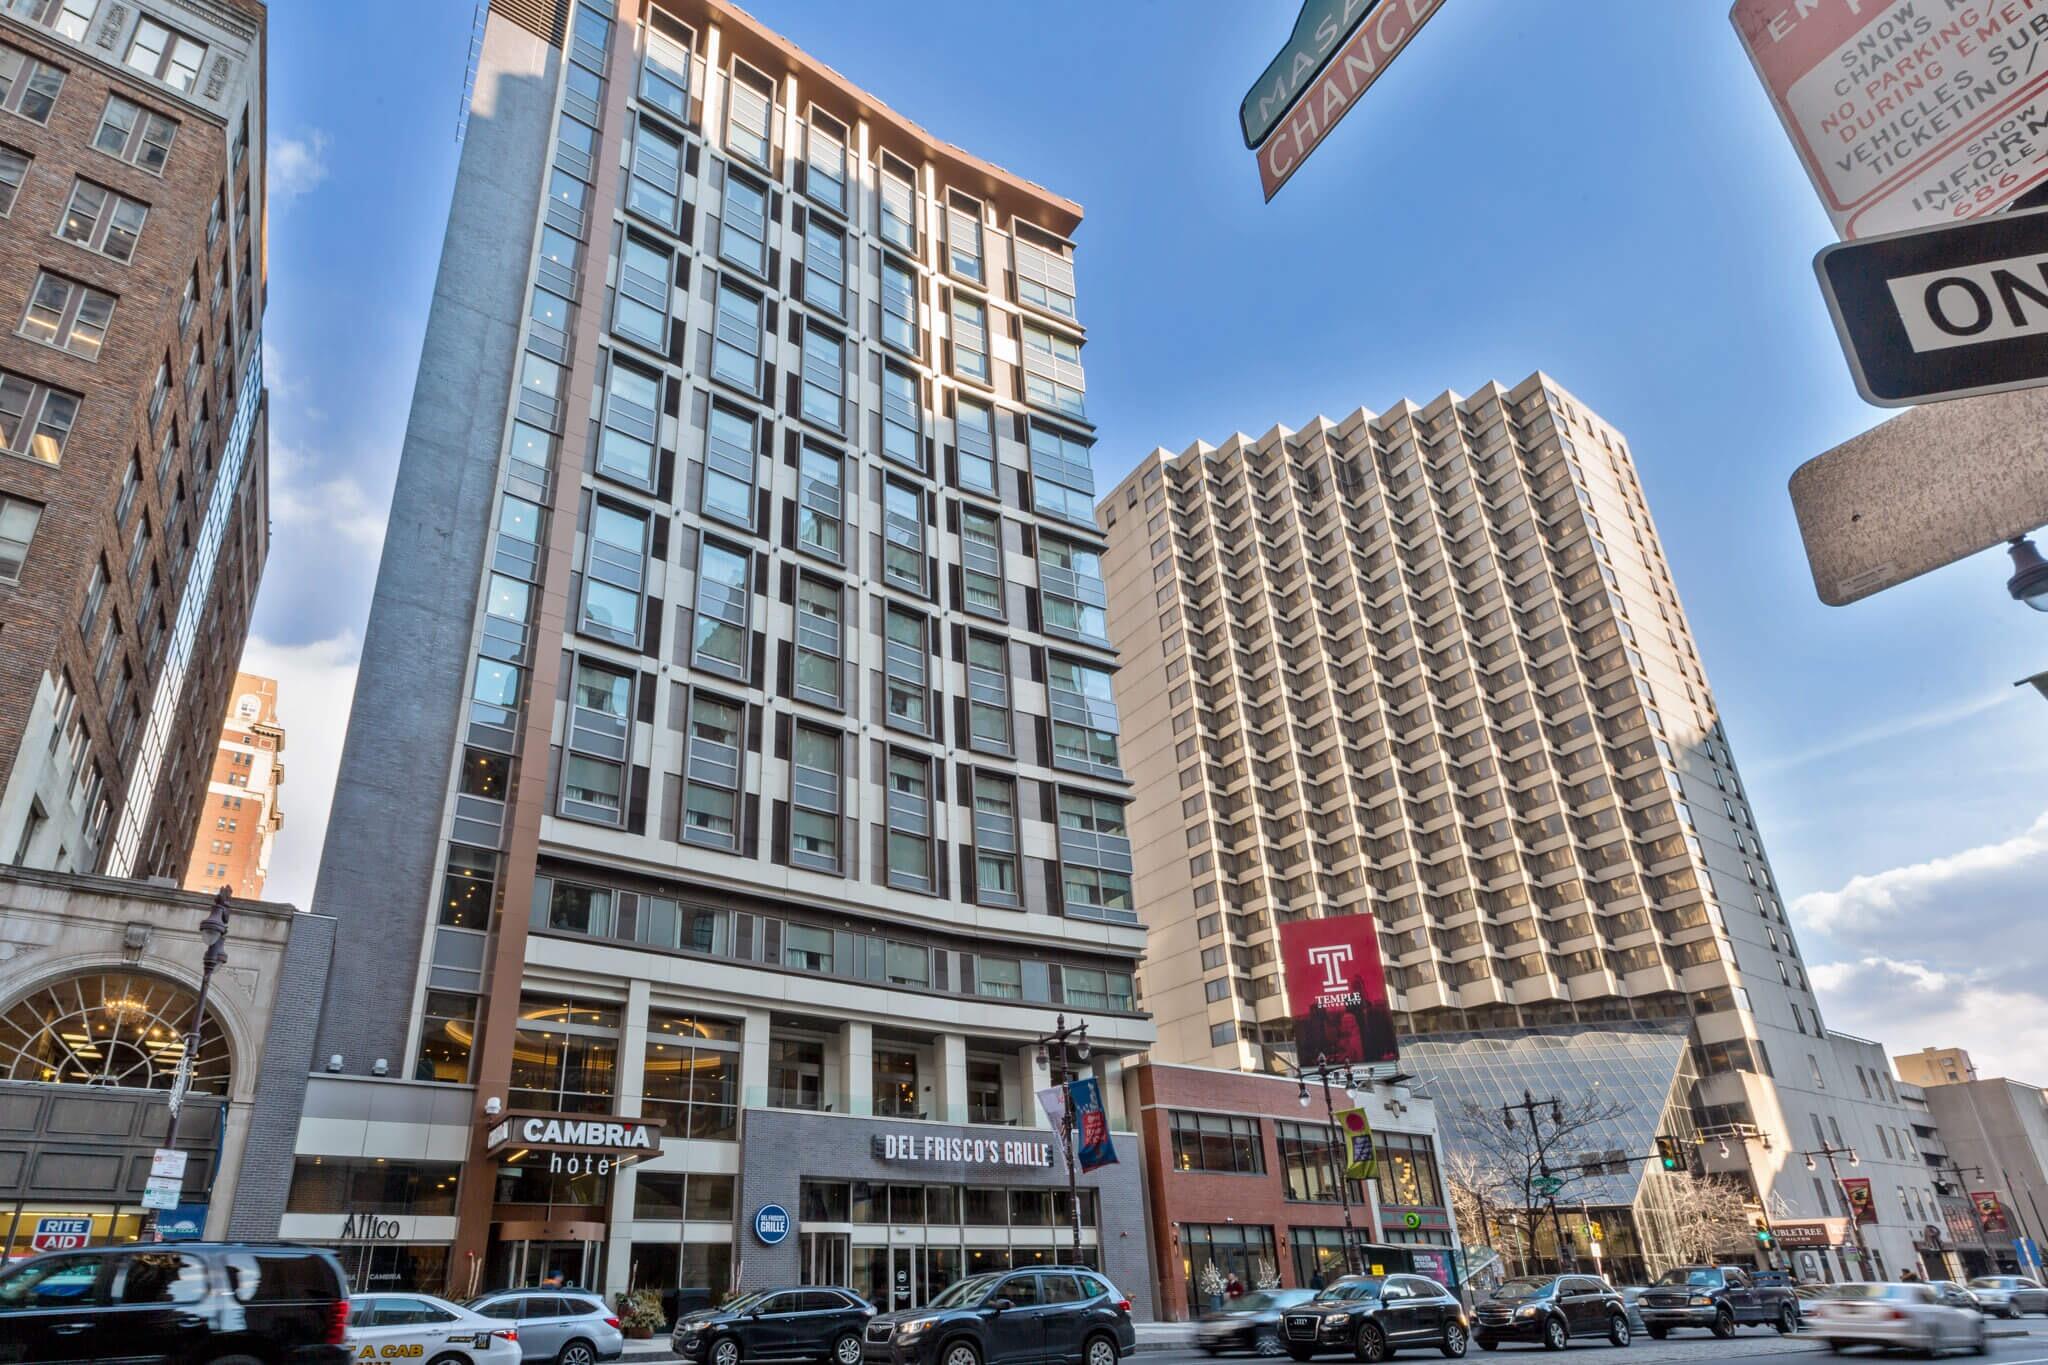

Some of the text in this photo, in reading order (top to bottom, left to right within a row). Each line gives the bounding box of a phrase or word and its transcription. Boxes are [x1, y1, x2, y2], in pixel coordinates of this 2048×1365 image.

[1840, 2, 1915, 69] SNOW
[1834, 16, 1932, 97] CHAINS
[1839, 0, 2033, 144] DURING EME
[1820, 102, 1856, 135] NO
[1836, 69, 1974, 173] VEHICLES
[1966, 105, 2036, 157] SNOW
[1932, 143, 2037, 211] VEHICLE
[1924, 262, 2048, 337] ON
[1314, 992, 1361, 1005] TEMPLE
[550, 1152, 620, 1176] hotel
[885, 1134, 1050, 1167] DEL FRISCO'S GRILLE
[43, 1236, 77, 1249] AID
[45, 1220, 85, 1232] RITE
[760, 1221, 786, 1232] GRILLE
[1772, 1227, 1825, 1238] UBLETREE
[359, 1344, 376, 1359] A
[381, 1344, 424, 1358] CAB
